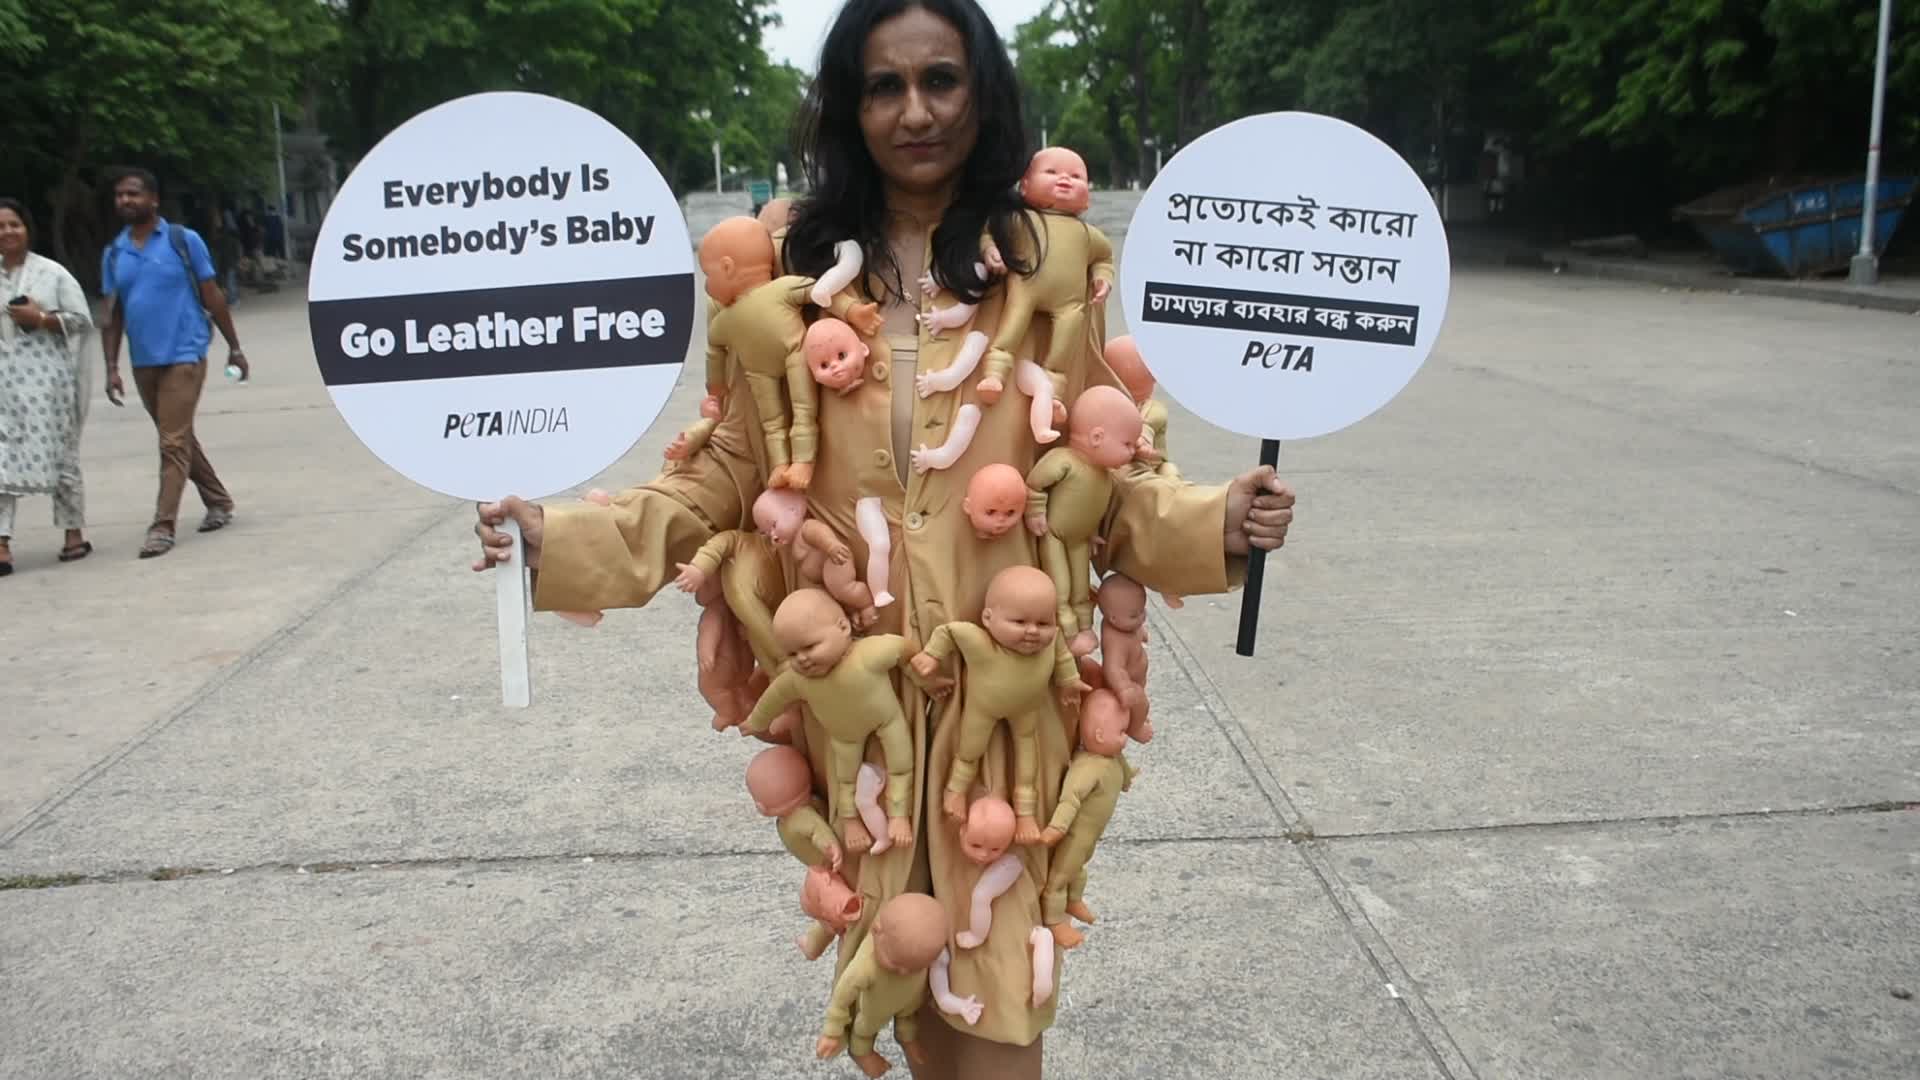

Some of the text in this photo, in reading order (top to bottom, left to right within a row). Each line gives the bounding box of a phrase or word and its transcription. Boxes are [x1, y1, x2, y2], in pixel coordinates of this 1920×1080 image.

[384, 164, 609, 208] Everybody Is
[343, 211, 654, 262] Somebody’s Baby
[1168, 193, 1418, 237] প্রত্যেকেই কারো
[1173, 240, 1401, 283] না কারো সন্তান
[341, 306, 665, 358] Go Leather Free
[1150, 293, 1414, 334] চামড়ার ব্যবহার বন্ধ করুন
